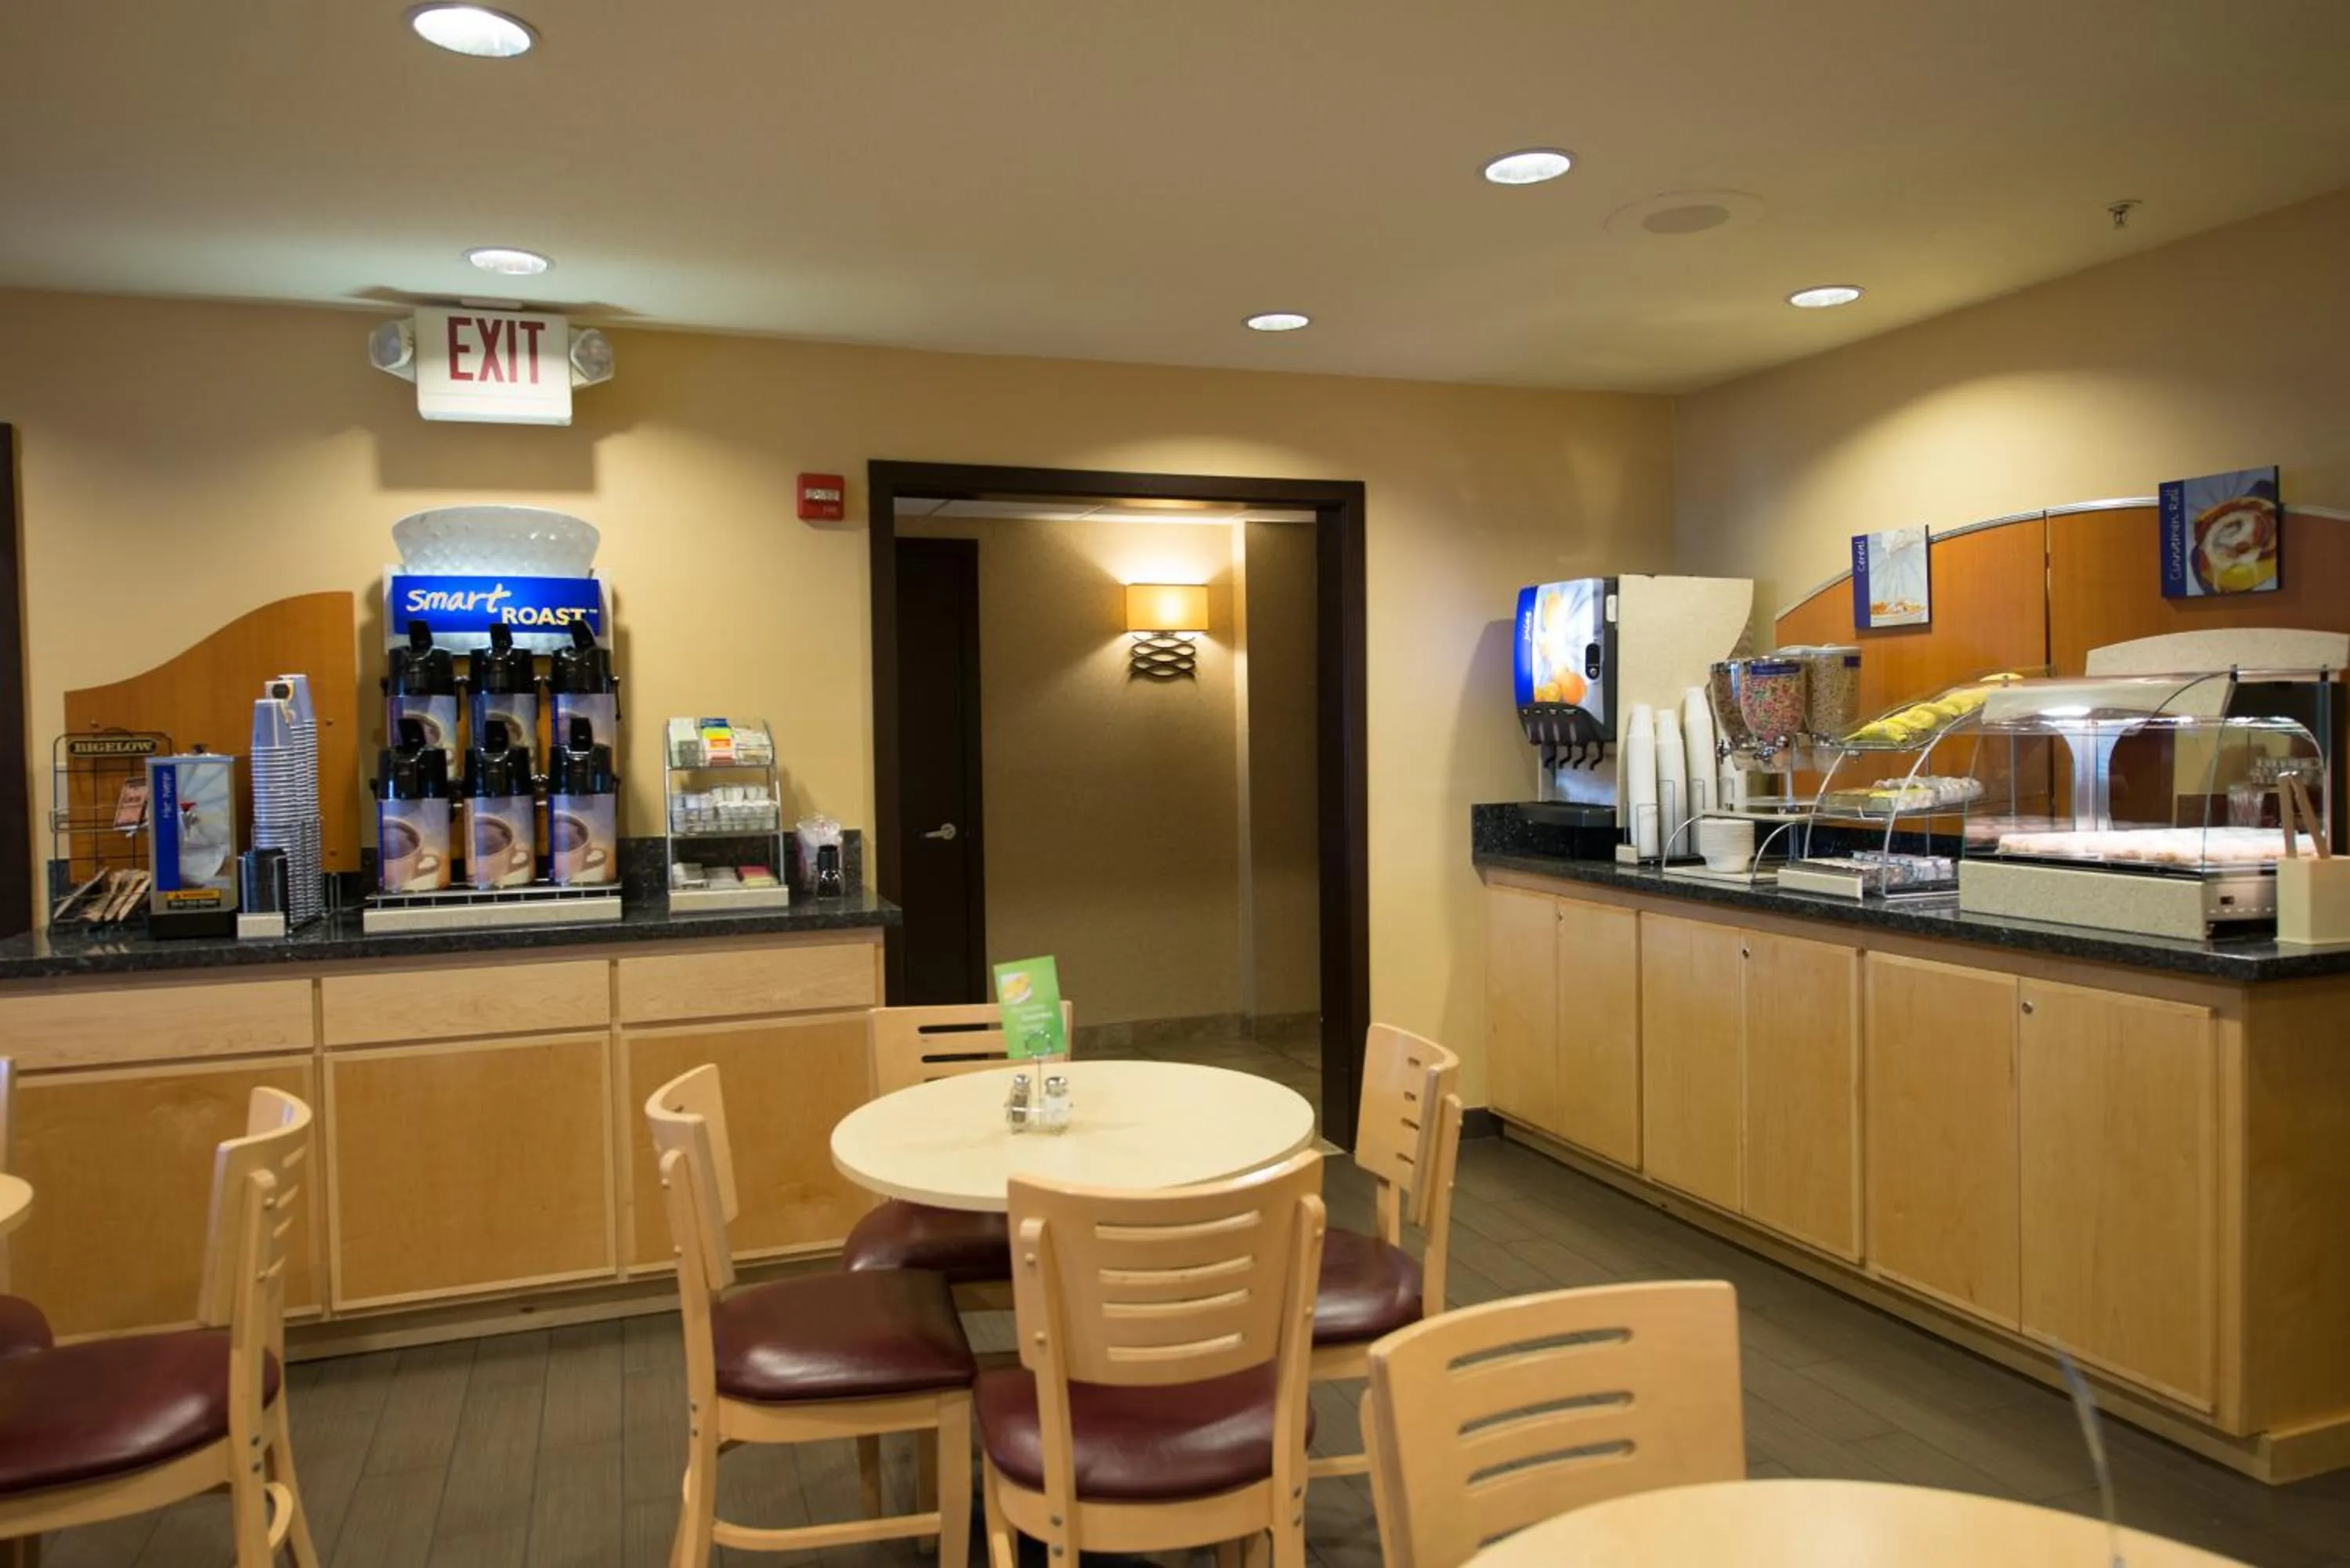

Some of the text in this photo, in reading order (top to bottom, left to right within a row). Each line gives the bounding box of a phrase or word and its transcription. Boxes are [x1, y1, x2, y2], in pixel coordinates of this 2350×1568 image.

[447, 316, 546, 385] EXIT
[1854, 540, 1866, 573] Cereal
[501, 606, 587, 626] ROAST
[74, 742, 152, 753] BIGELOW
